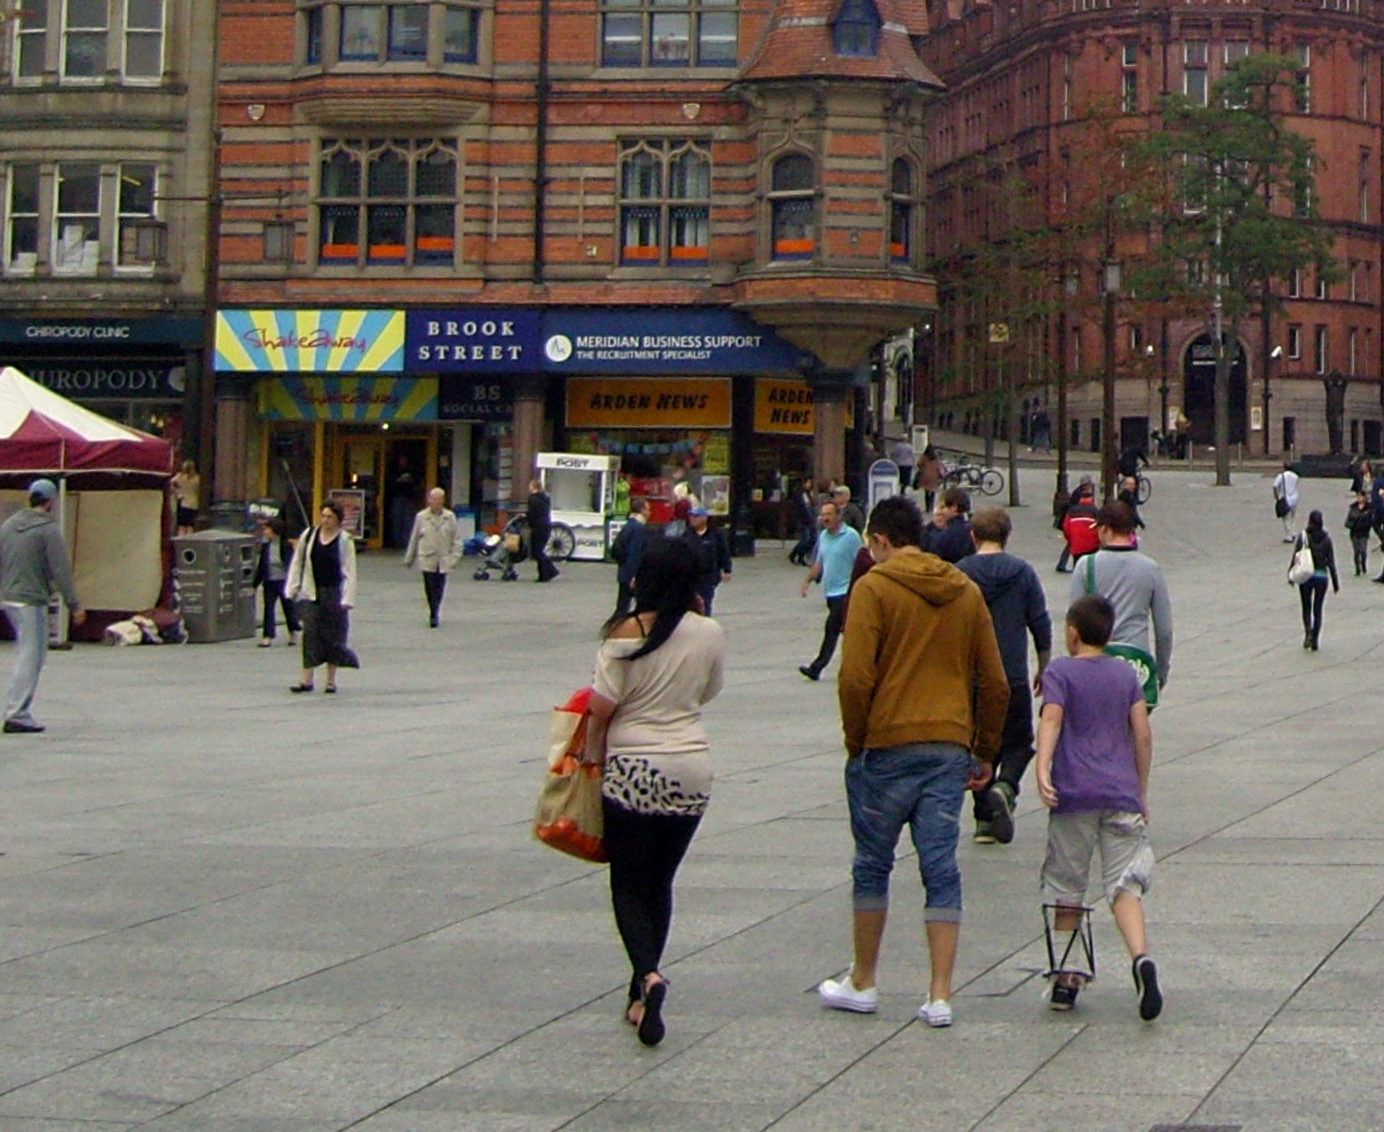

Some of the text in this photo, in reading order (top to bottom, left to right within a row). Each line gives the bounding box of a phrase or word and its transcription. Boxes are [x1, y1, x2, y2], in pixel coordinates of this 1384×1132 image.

[26, 326, 131, 338] CHIROPODY CLINIC
[427, 321, 515, 336] BROOK
[576, 336, 762, 348] MERIDIAN BUSINESS SUPPORT
[418, 345, 522, 360] STREET
[576, 350, 712, 359] THE RECRUITMENT SPECIALIST
[590, 394, 710, 410] ARDEN NEWS
[768, 387, 813, 404] ARDEN
[770, 409, 812, 425] NEWS
[556, 458, 590, 468] POST
[577, 538, 604, 549] POST
